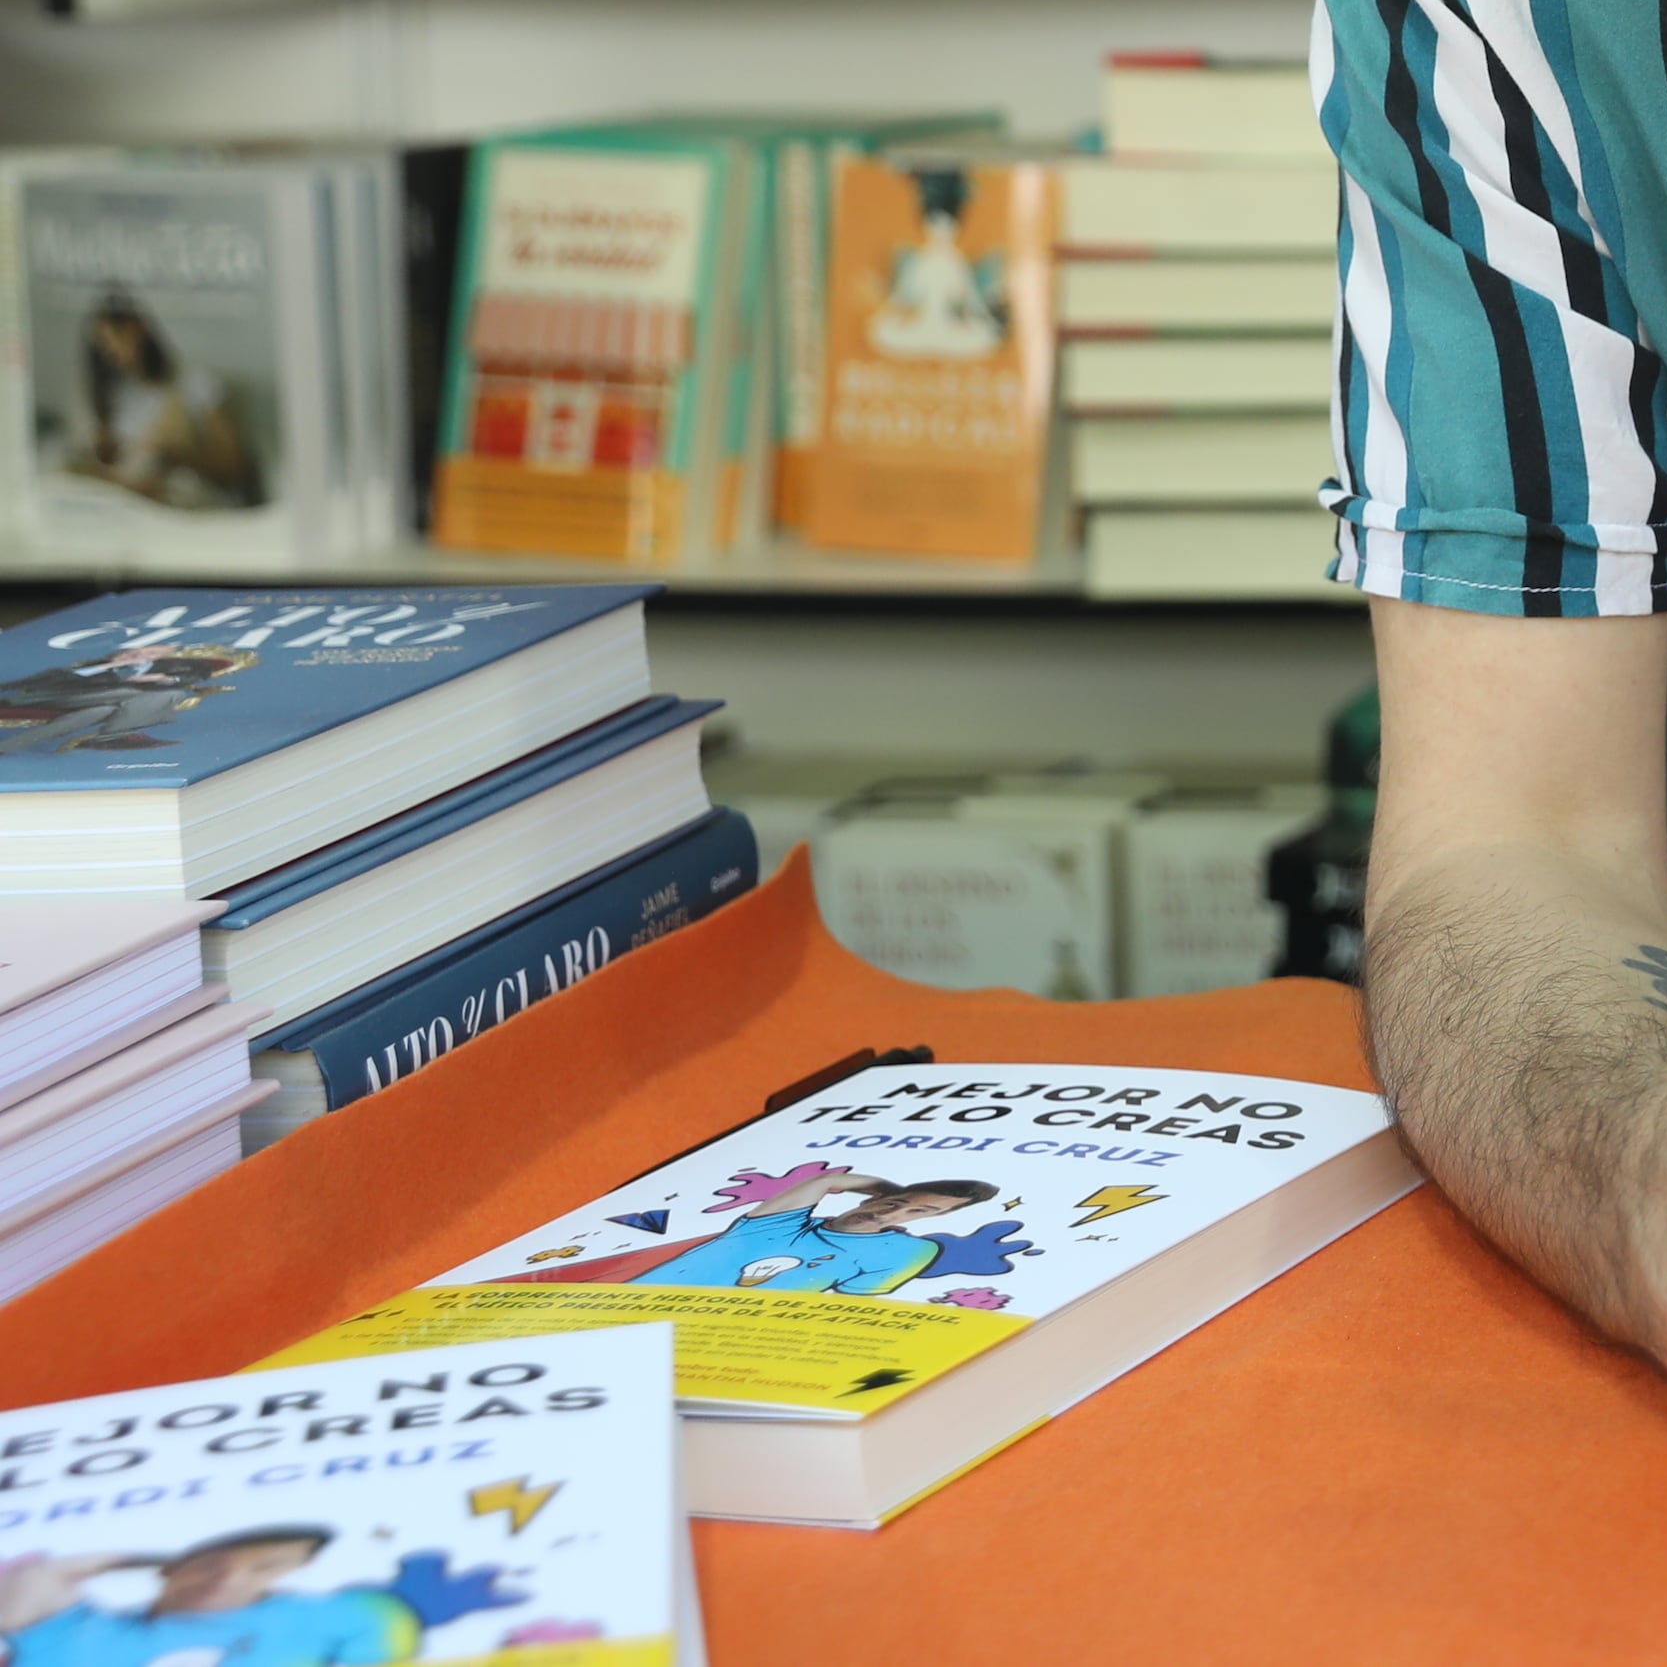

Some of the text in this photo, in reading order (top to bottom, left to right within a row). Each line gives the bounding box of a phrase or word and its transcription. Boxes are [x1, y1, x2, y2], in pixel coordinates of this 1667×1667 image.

[641, 881, 680, 920] JAIME
[881, 1081, 1303, 1120] MEJOR NO
[800, 1104, 1306, 1151] TE LO CREAS
[805, 1134, 1185, 1168] JORDI CRUZ
[431, 1291, 961, 1325] LA SORPRENDENTE HISTORIA DE JORDI CRUZ,
[434, 1300, 919, 1331] EL MÍTICO PRESENTADOR DE ART ATTACK.
[376, 1362, 549, 1403] NO
[0, 1384, 609, 1492] LO CREAS
[247, 1438, 497, 1487] CRUZ
